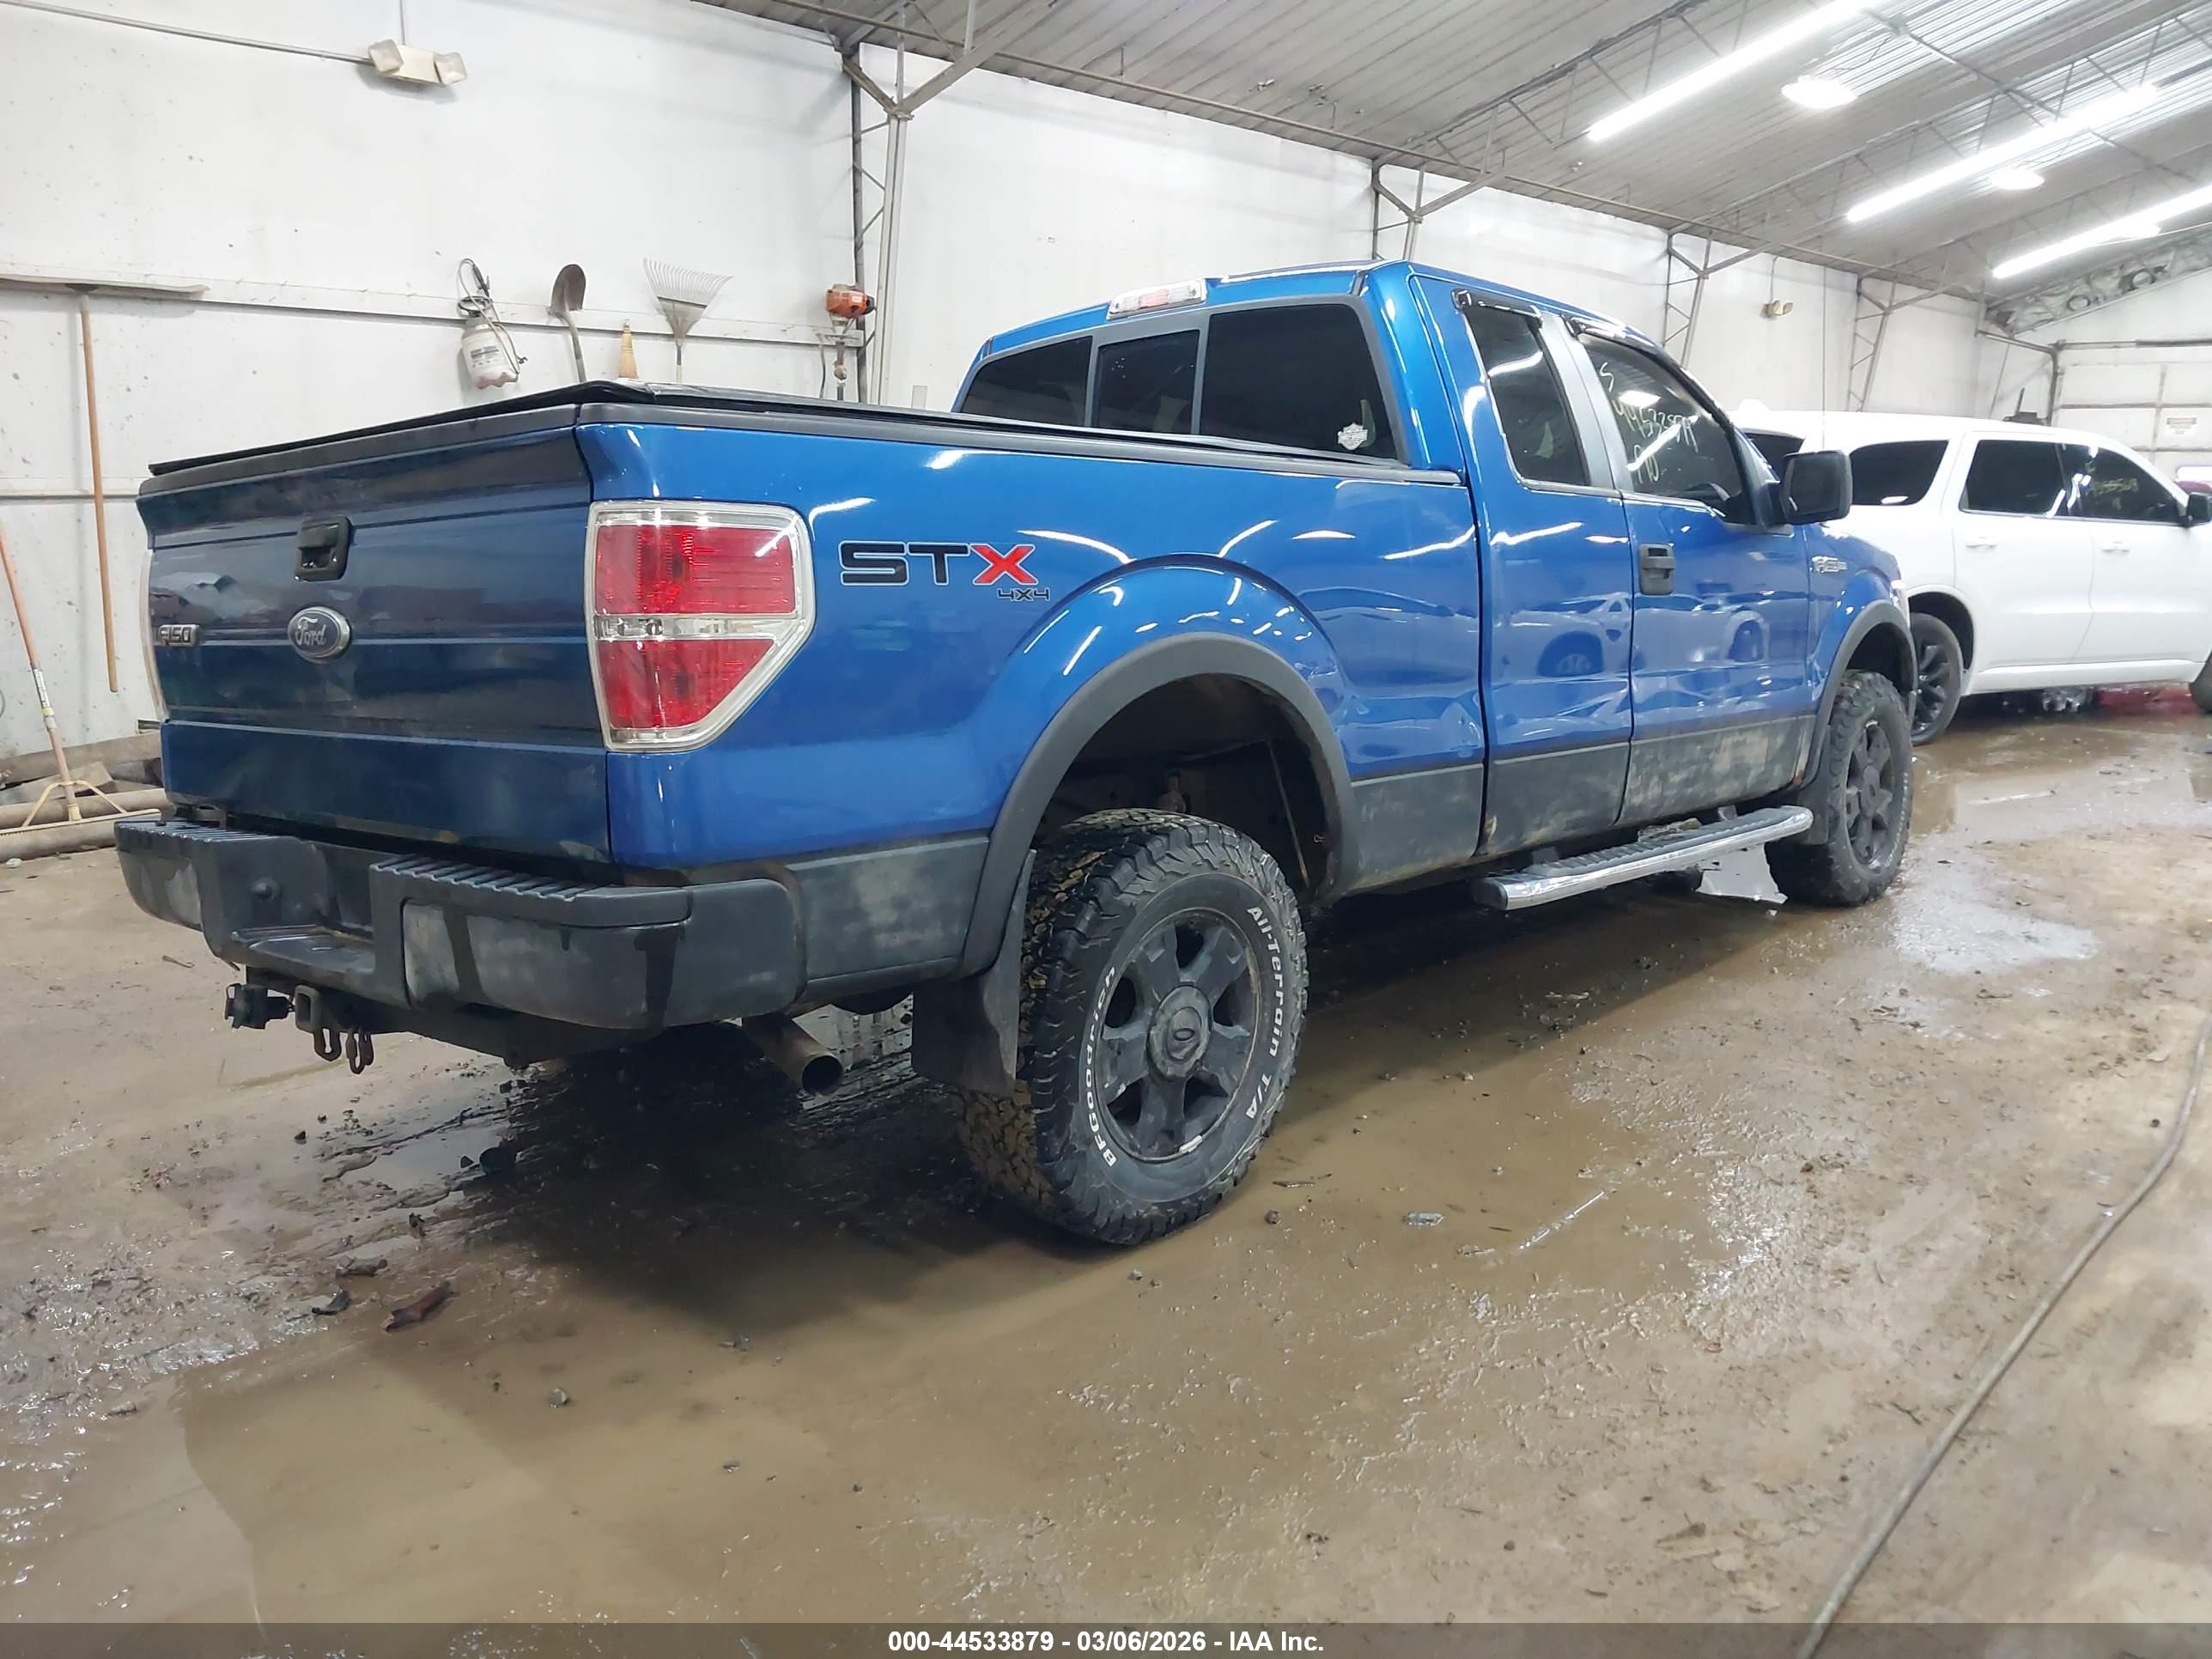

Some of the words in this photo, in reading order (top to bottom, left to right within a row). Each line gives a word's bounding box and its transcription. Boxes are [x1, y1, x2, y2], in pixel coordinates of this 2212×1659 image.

[838, 540, 1039, 586] STX
[295, 617, 327, 647] Ford
[1247, 907, 1285, 1058] All-Terrain
[1085, 966, 1116, 1167] BFGoodrich
[1246, 1073, 1272, 1120] T/A
